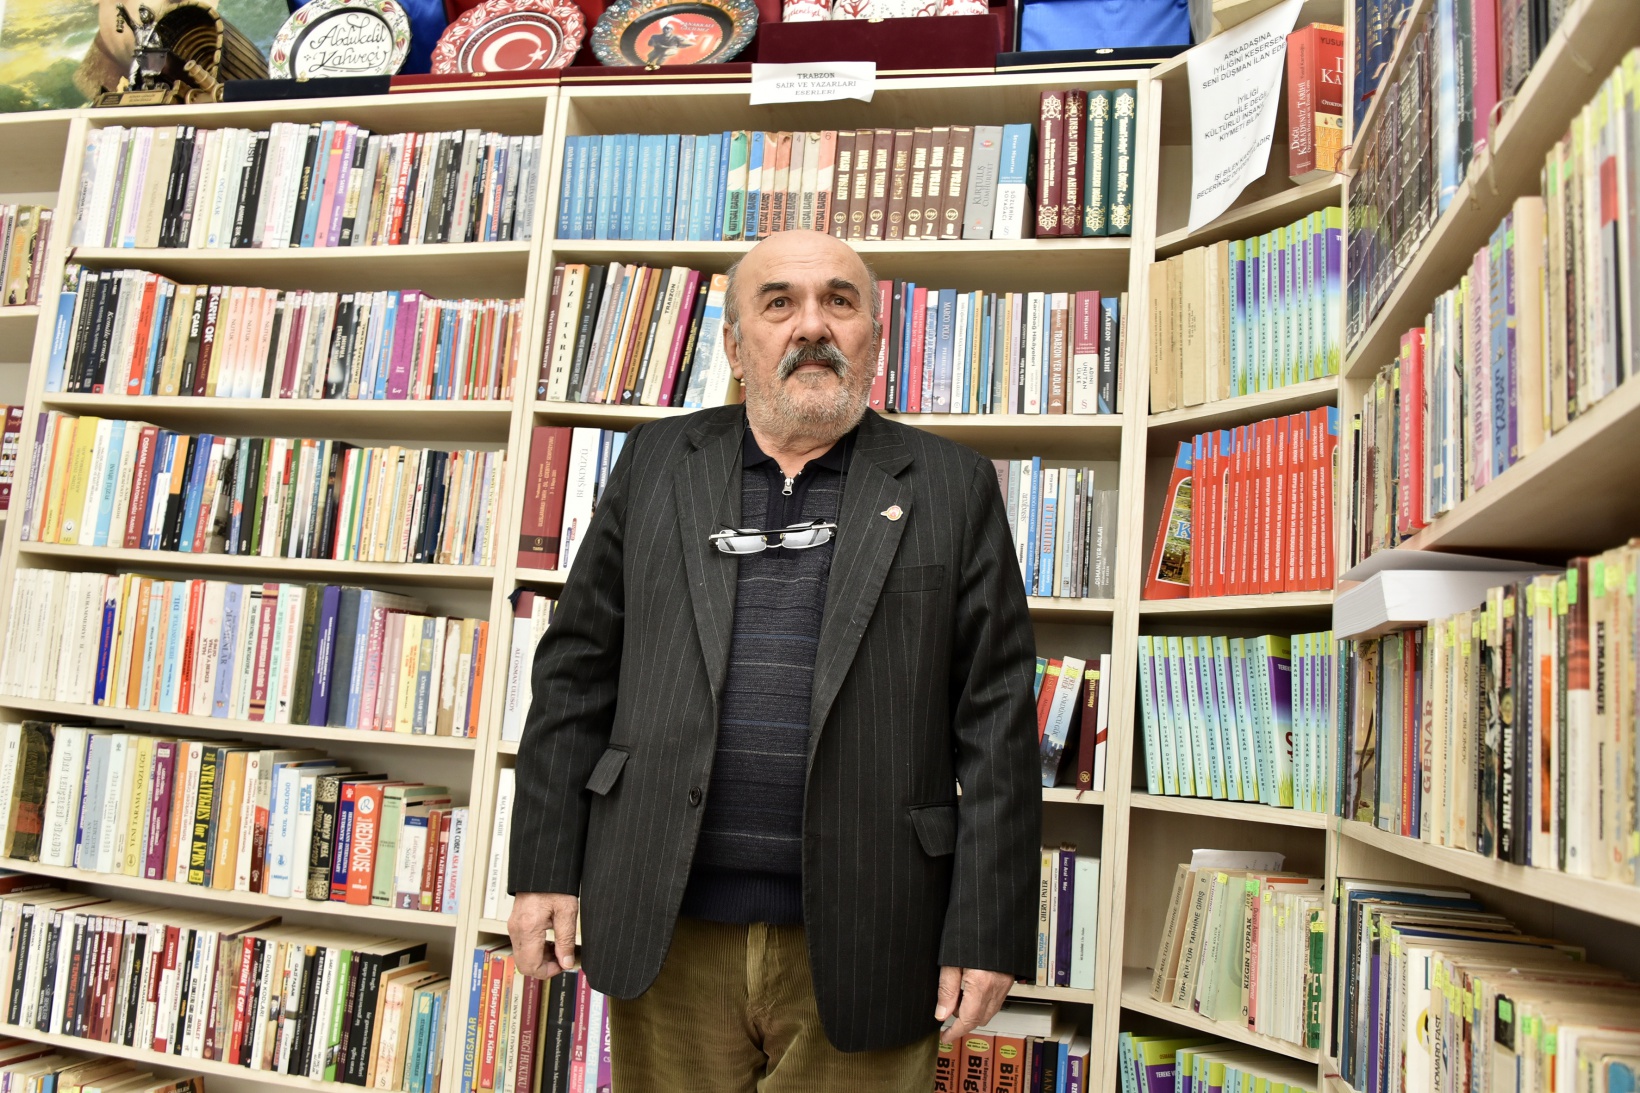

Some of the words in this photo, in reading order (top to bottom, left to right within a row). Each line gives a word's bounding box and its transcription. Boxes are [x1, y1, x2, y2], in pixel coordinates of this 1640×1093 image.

[1224, 31, 1272, 60] ARKADAŞINA
[1244, 34, 1285, 59] KESERSEN
[1224, 103, 1249, 121] CAHİLE
[1204, 115, 1241, 139] KÜLTÜRLÜ
[1068, 142, 1078, 165] DÜNYA
[397, 186, 406, 200] CHP
[399, 177, 408, 185] VE
[972, 165, 985, 206] KURTULUŞ
[1008, 191, 1016, 221] SÖZLERİN
[728, 211, 738, 231] KUTSAL
[664, 283, 676, 314] TRABZON
[943, 302, 951, 322] MARCO
[190, 313, 200, 337] ÇALDI
[204, 326, 214, 343] OK
[228, 318, 237, 341] NUTUK
[244, 320, 252, 342] NUTUK
[262, 321, 270, 343] NUTUK
[1104, 308, 1112, 342] TRABZON
[1054, 330, 1062, 358] TRABZON
[877, 338, 886, 376] ERZURUM
[1053, 360, 1062, 372] YER
[1103, 347, 1112, 372] TARİHİ
[1052, 374, 1061, 396] ADLARI
[139, 437, 150, 467] OSMANLI
[197, 764, 215, 820] STRATEGIES
[194, 824, 207, 837] for
[345, 812, 353, 842] HEINEMANN
[192, 841, 207, 866] KPDS
[352, 822, 374, 872] REDHOUSE
[411, 836, 420, 859] Latince
[409, 861, 417, 883] Türkçe
[1178, 981, 1188, 1001] TÜRK
[1195, 890, 1205, 911] GİRİŞ
[241, 948, 251, 984] ATATÜRK
[1243, 957, 1251, 990] KIZGIN
[239, 986, 248, 995] VE
[260, 986, 268, 1017] KODLARI
[490, 979, 501, 1018] Bilgisayar
[237, 997, 246, 1012] CHP
[488, 1019, 497, 1038] Kurs
[486, 1040, 495, 1064] Kitabı
[521, 1030, 532, 1053] VERGİ
[518, 1054, 530, 1088] HUKUKU
